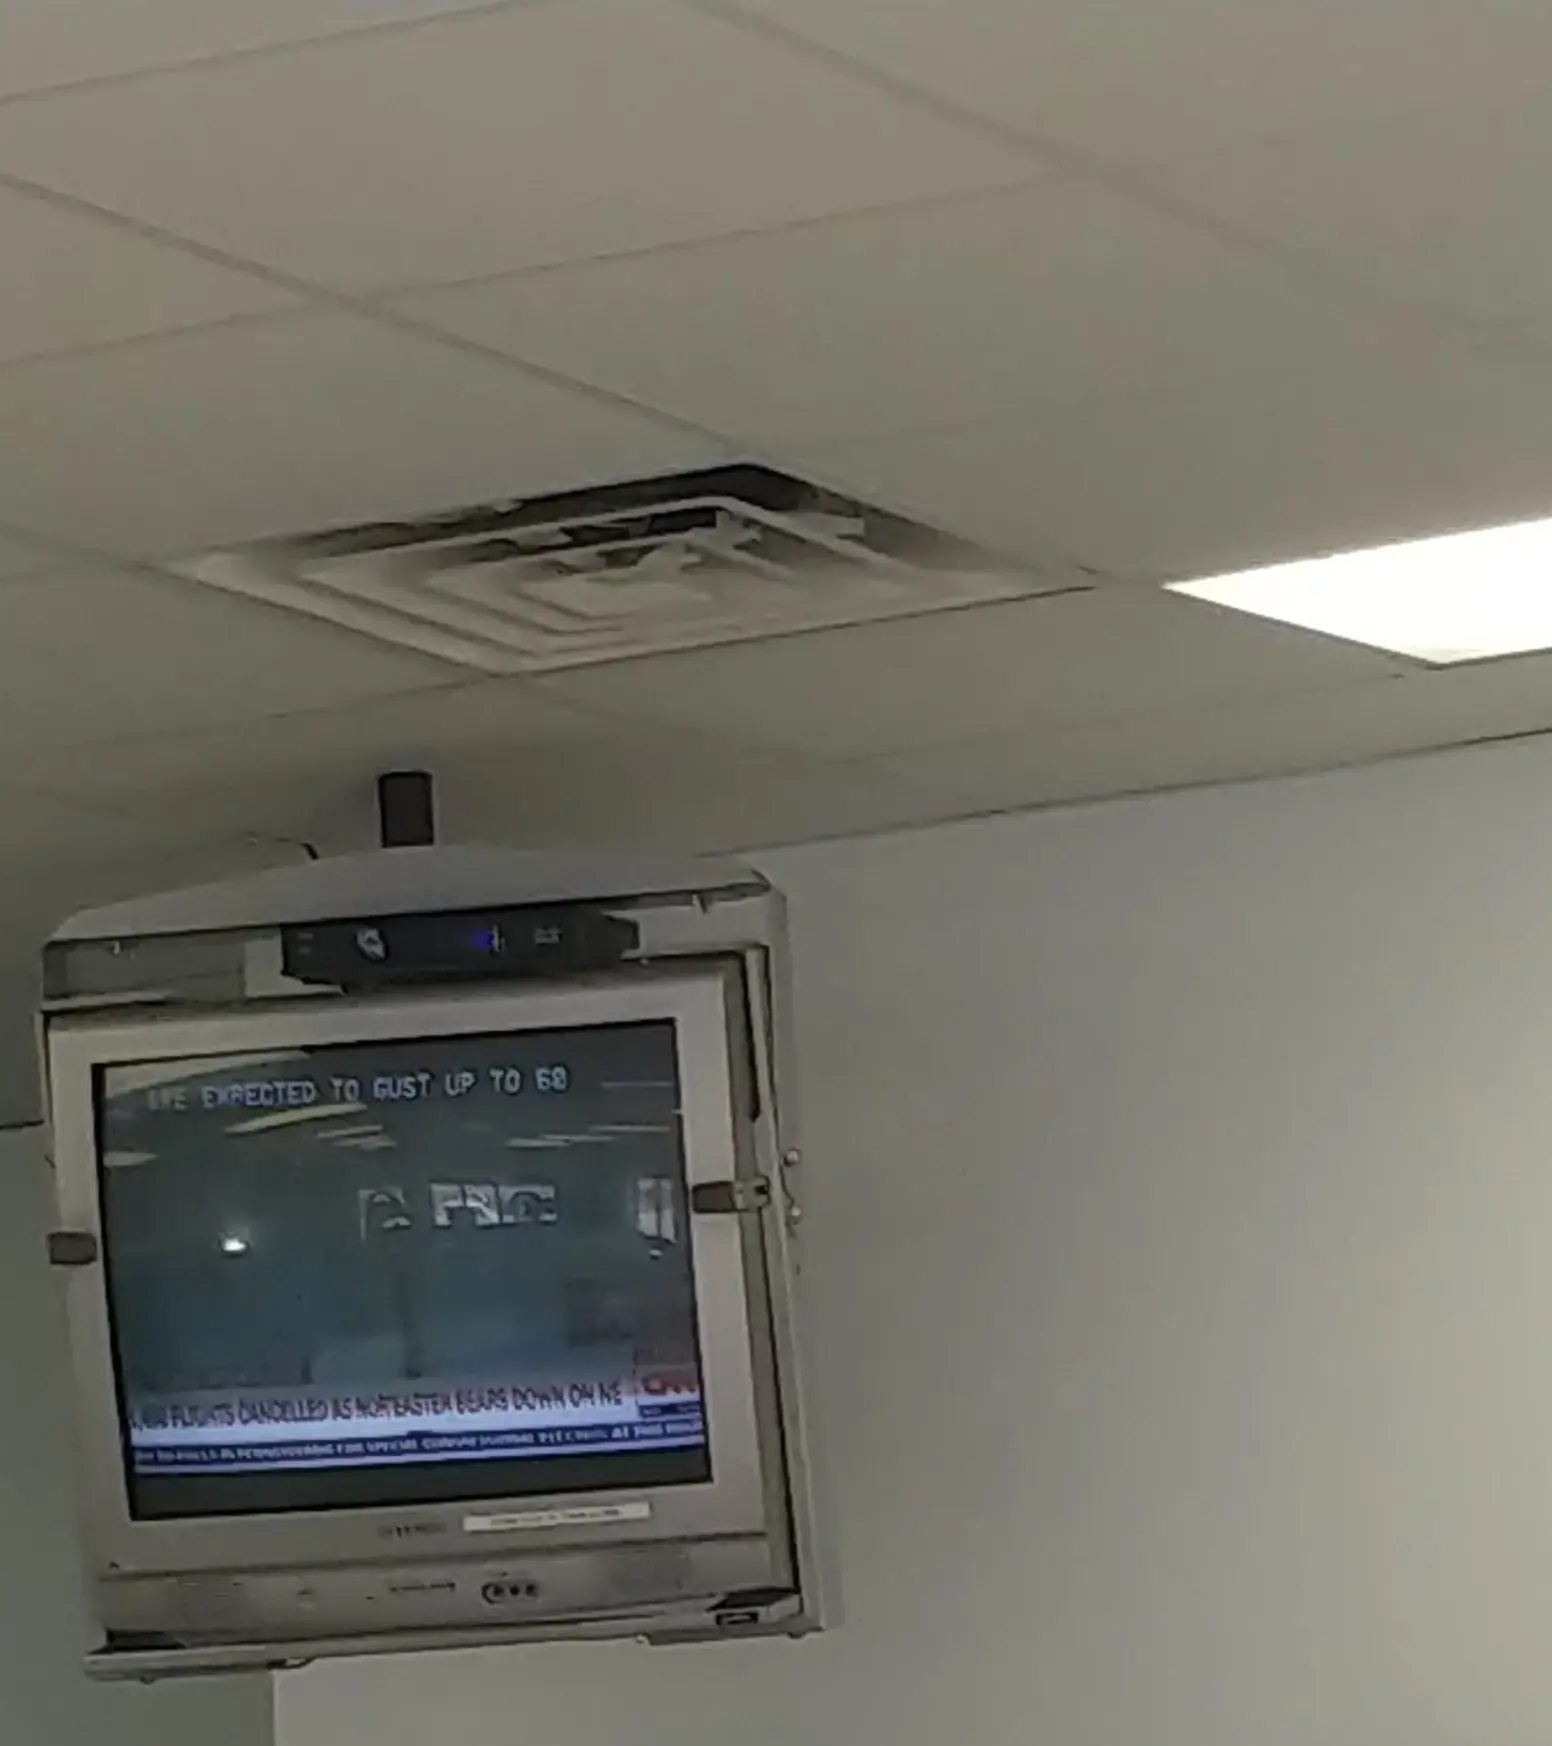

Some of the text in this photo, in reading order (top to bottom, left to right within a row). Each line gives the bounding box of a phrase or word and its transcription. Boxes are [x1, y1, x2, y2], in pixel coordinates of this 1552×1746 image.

[330, 1077, 359, 1103] TO
[372, 1073, 433, 1100] GUST
[444, 1072, 476, 1097] UP
[490, 1068, 521, 1093] TO
